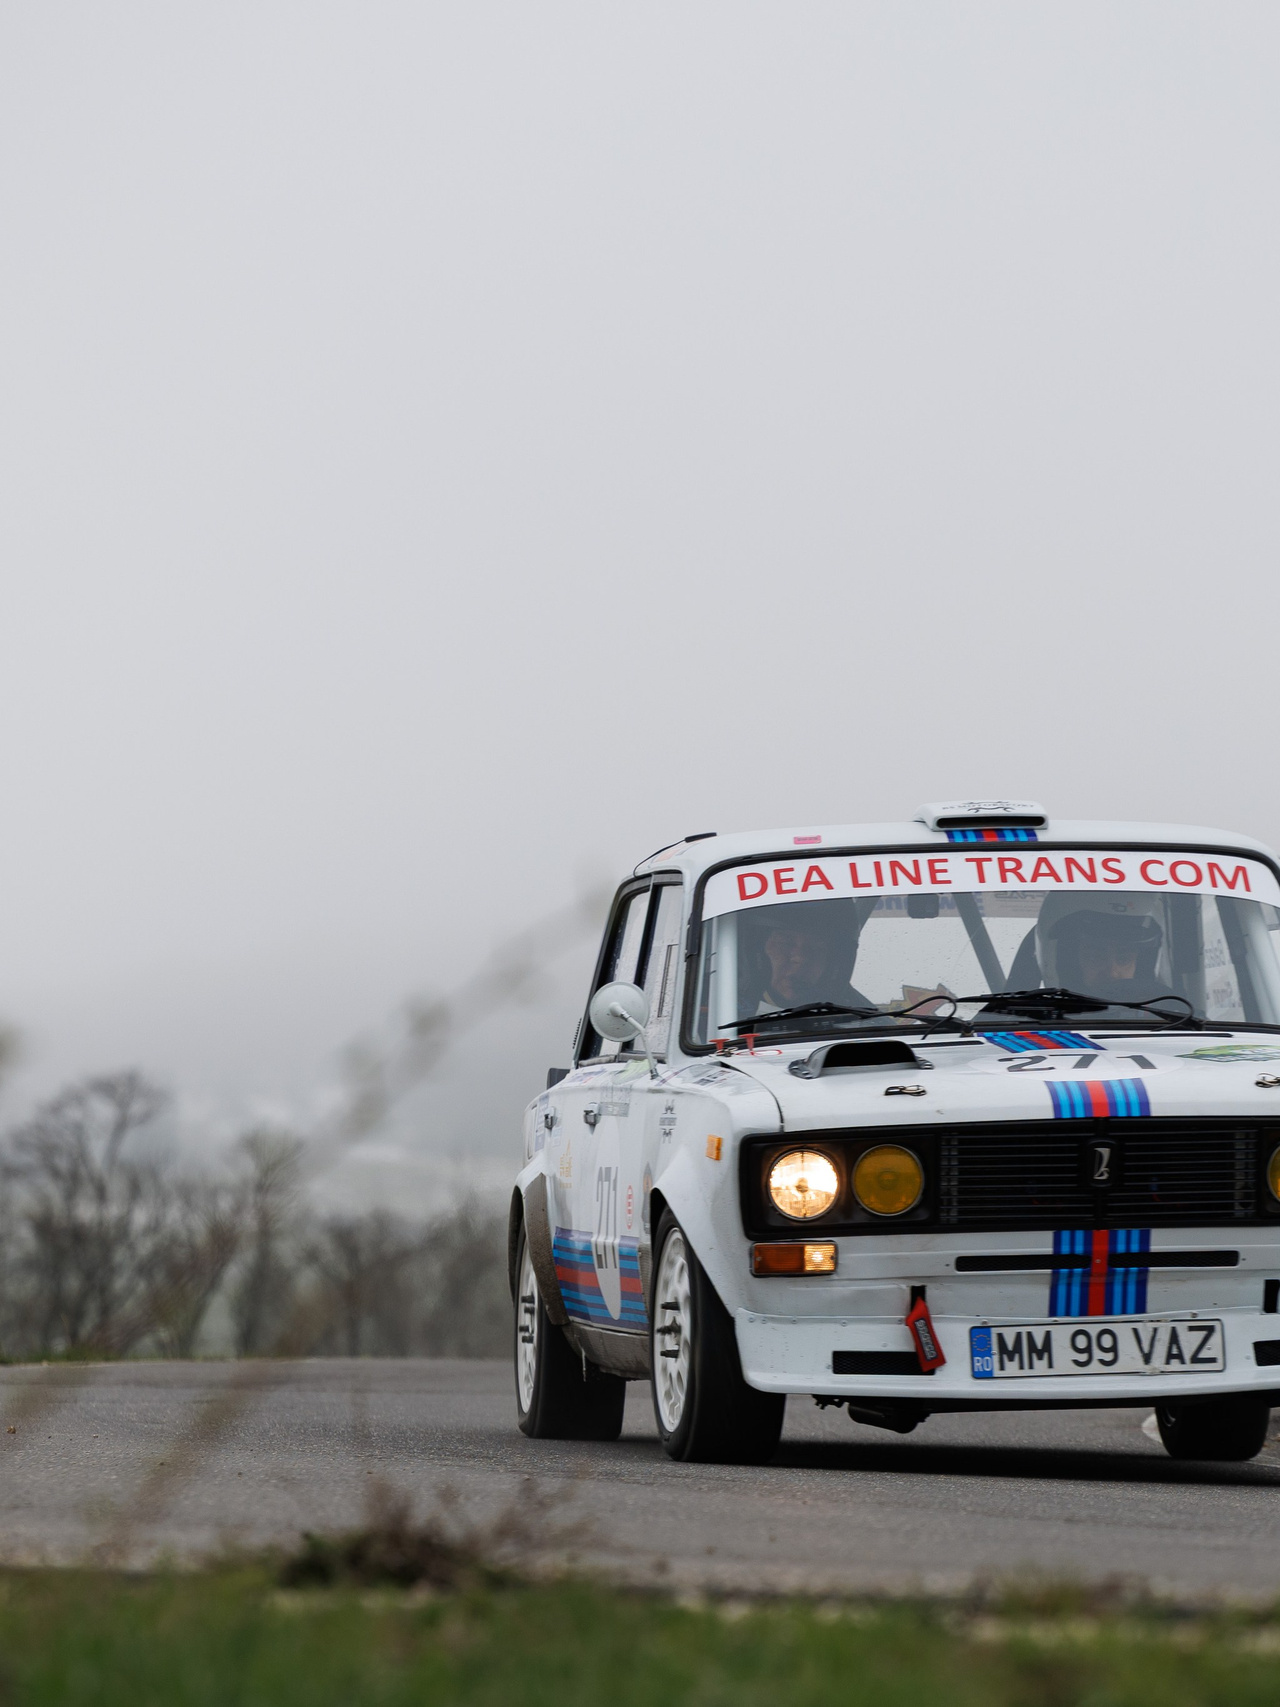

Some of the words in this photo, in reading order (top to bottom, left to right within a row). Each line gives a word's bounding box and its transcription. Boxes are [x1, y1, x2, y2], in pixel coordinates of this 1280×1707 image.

[737, 865, 834, 901] DEA
[848, 858, 952, 889] LINE
[965, 857, 1125, 885] TRANS
[1139, 859, 1252, 893] COM
[997, 1053, 1158, 1073] 271
[596, 1166, 618, 1269] 271
[973, 1356, 993, 1372] RO
[996, 1330, 1054, 1371] MM
[1070, 1328, 1118, 1368] 99
[1131, 1325, 1217, 1365] VAZ
